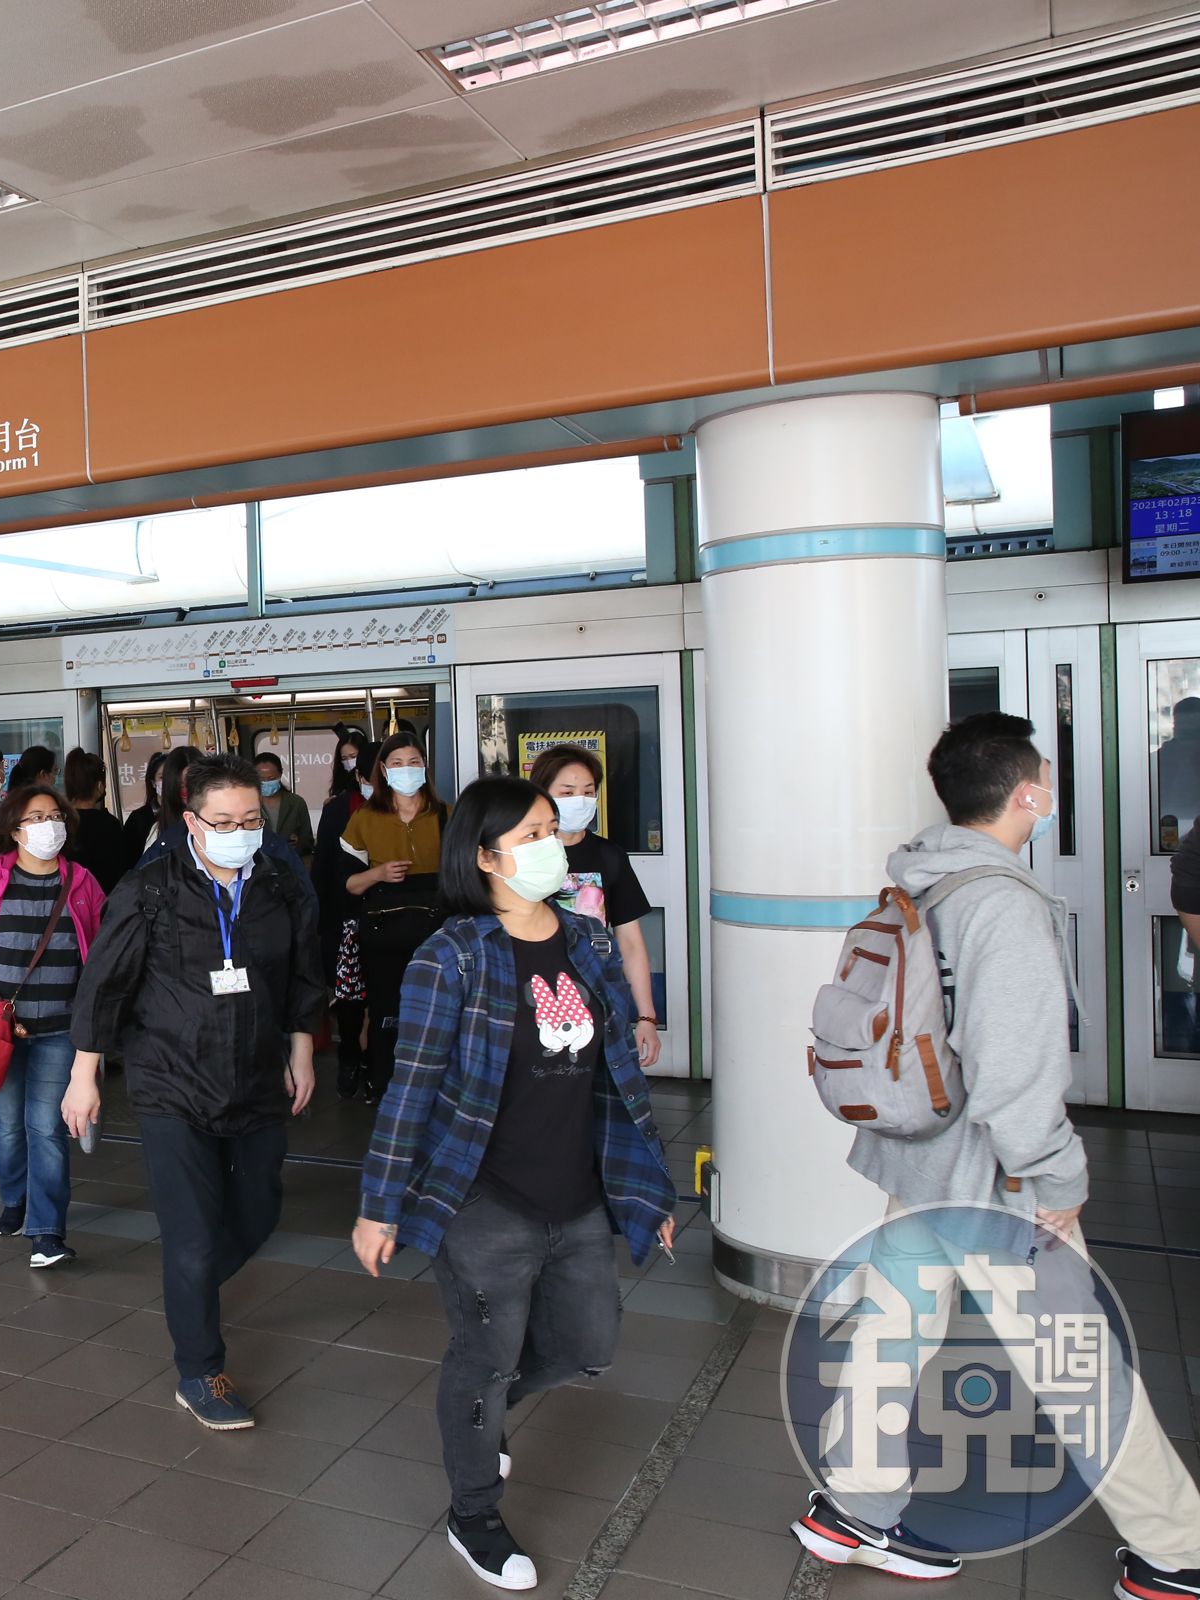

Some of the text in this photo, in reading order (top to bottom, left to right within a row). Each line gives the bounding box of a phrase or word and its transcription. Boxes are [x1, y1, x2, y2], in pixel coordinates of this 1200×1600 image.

[32, 451, 40, 467] 1
[1154, 522, 1190, 534] 星期二
